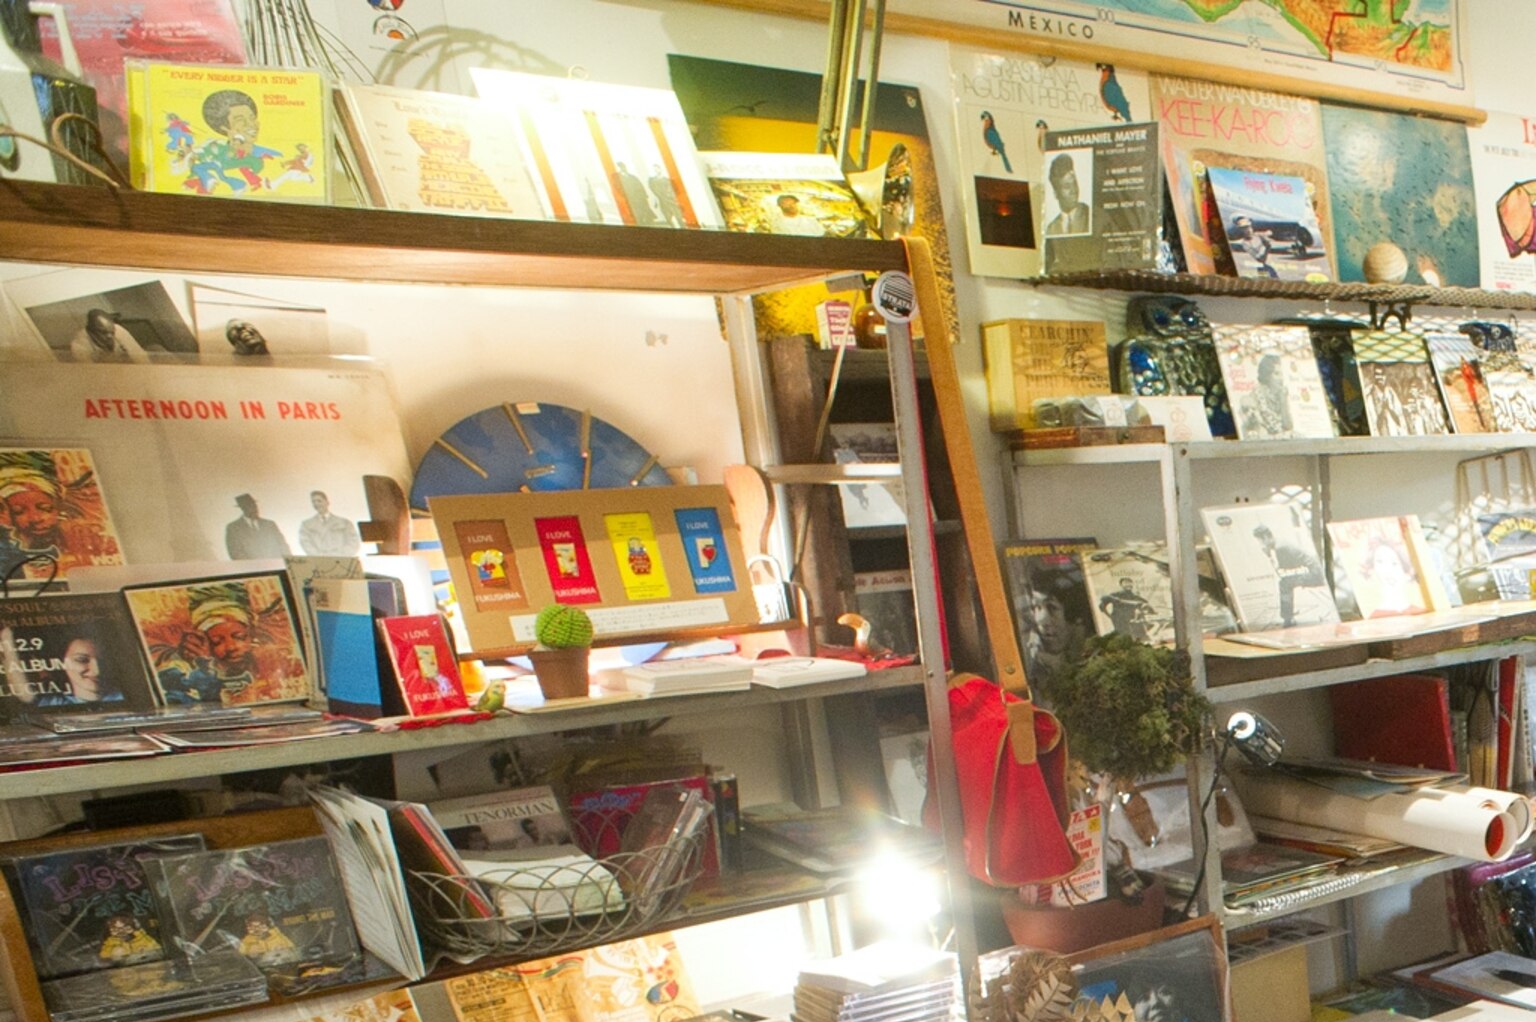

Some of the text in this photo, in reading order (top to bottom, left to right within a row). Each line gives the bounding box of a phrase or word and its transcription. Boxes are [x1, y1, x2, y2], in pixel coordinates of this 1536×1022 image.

[1058, 129, 1148, 147] NATHANIEL MAYER
[84, 399, 341, 420] AFTERNOON IN PARIS
[690, 521, 709, 530] LOVE
[472, 535, 494, 544] LOVE
[550, 530, 571, 540] LOVE
[459, 801, 555, 826] TENORMAN
